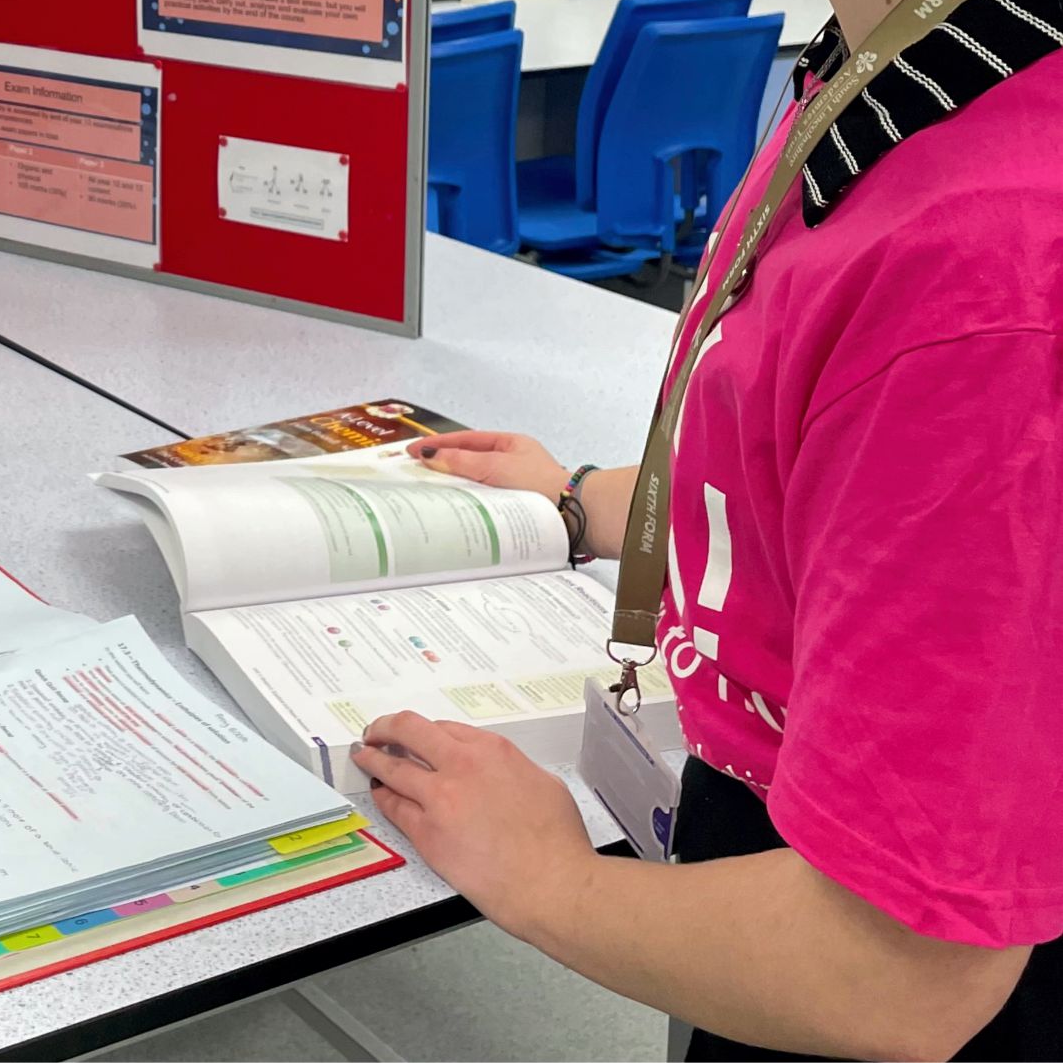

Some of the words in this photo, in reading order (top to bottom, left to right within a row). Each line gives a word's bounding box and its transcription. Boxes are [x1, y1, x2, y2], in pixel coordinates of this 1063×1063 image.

[4, 81, 30, 95] Exam
[33, 85, 82, 103] Information
[802, 67, 852, 126] Academies
[832, 77, 860, 105] South
[309, 416, 382, 448] Chemi
[340, 412, 396, 436] A-Level
[646, 472, 660, 514] SIXTH
[639, 514, 656, 554] FORM
[208, 726, 231, 744] solution
[290, 834, 302, 842] 2
[134, 898, 148, 907] 5
[74, 918, 88, 926] 6
